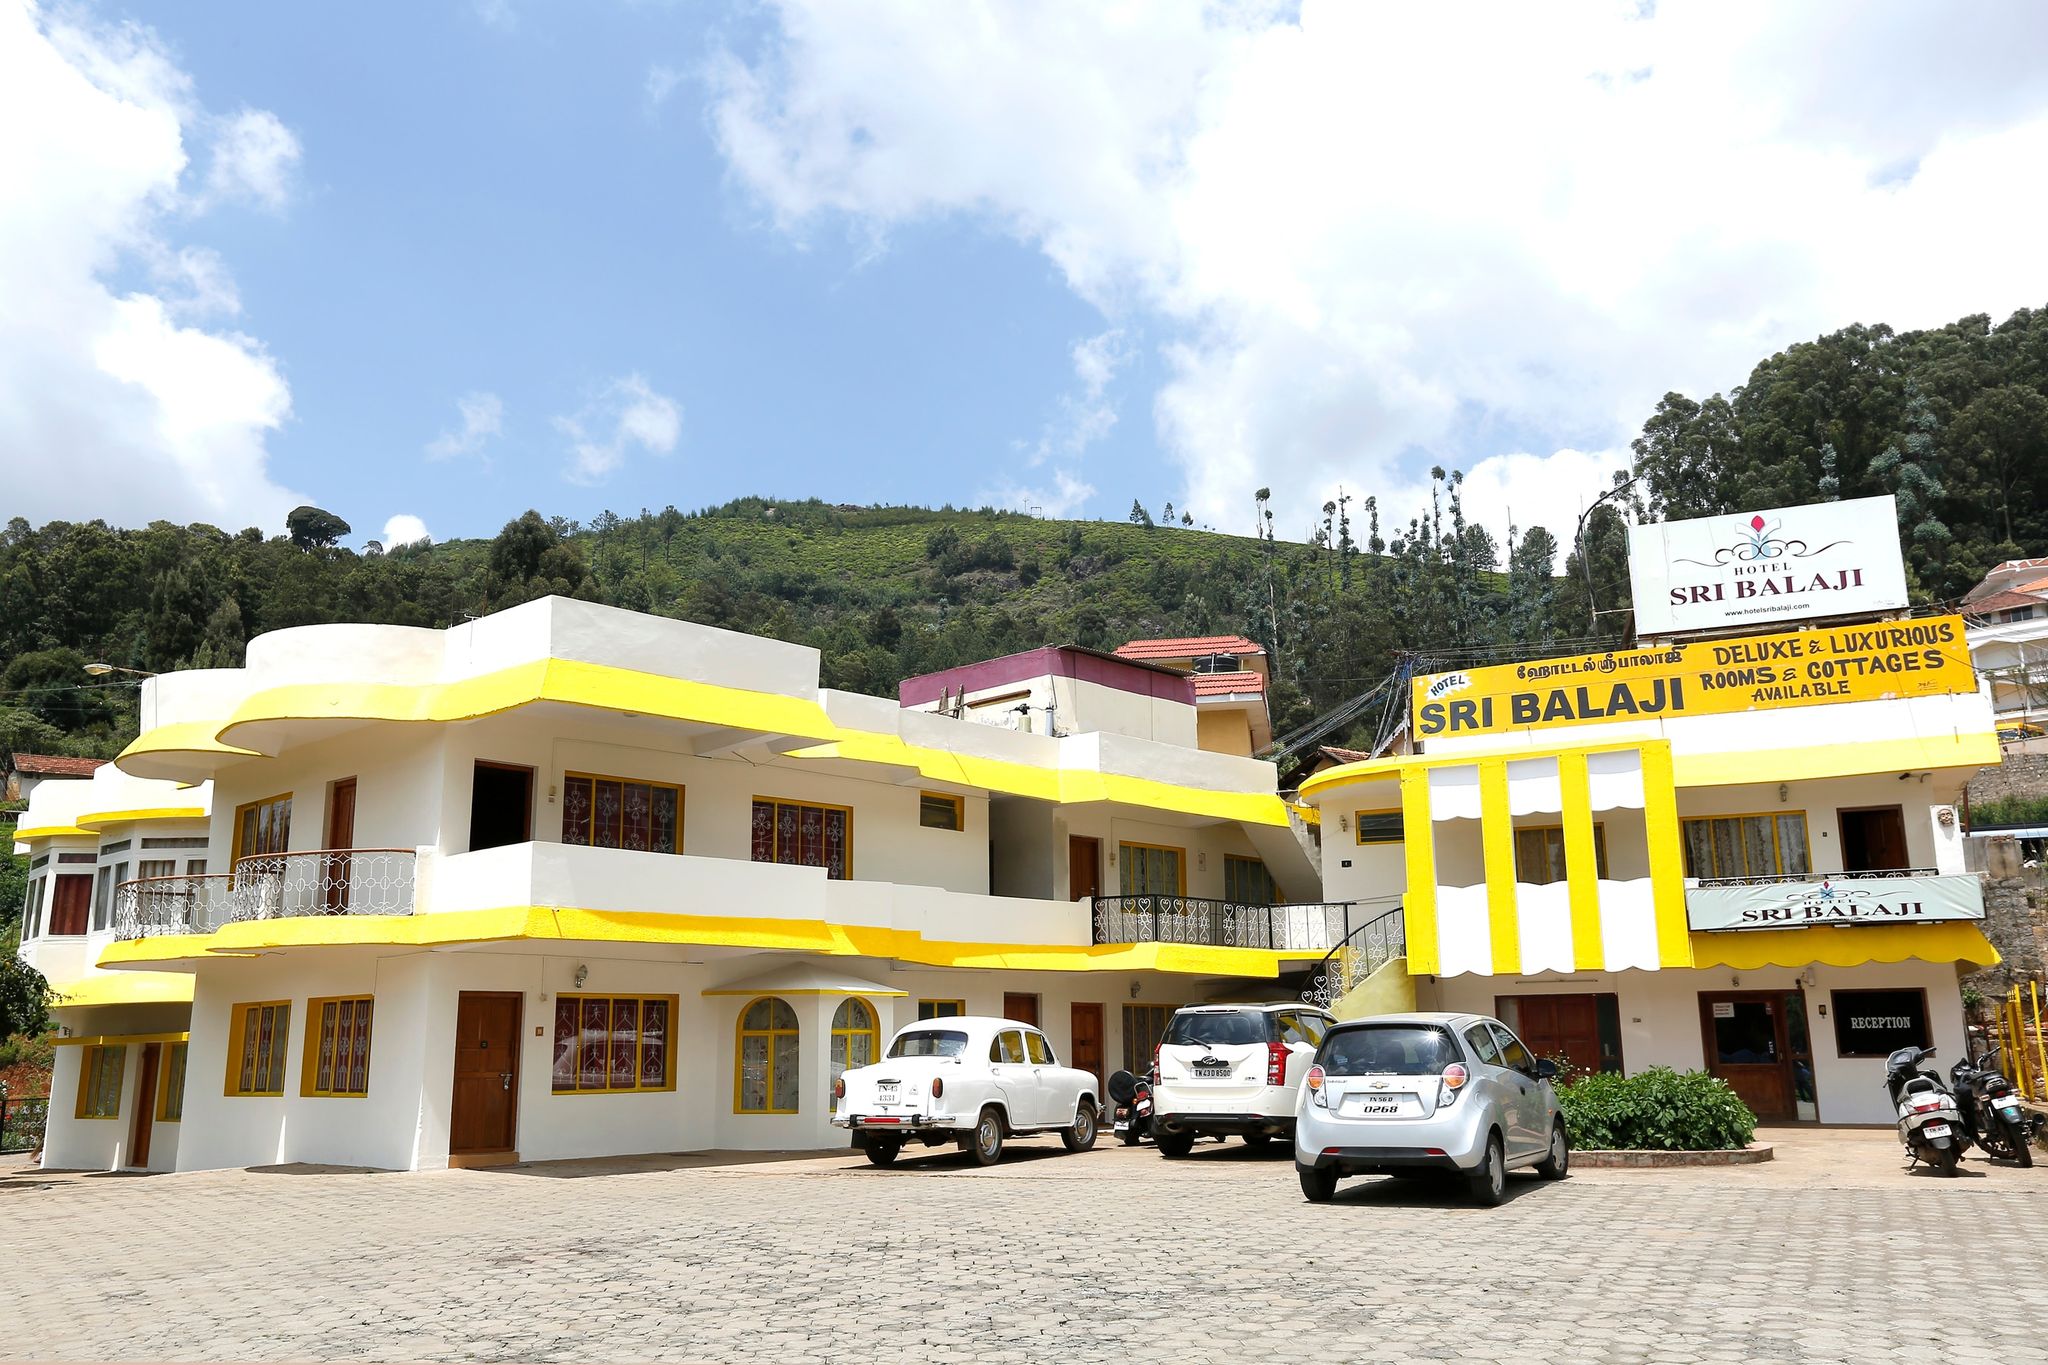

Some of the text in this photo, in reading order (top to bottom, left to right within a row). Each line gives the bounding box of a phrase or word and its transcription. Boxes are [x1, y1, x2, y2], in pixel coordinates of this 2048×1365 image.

[1734, 562, 1792, 576] HOTEL
[1670, 568, 1865, 606] SRI BALAJI
[1725, 603, 1810, 617] www.hotelsribalaji.com
[1712, 623, 1955, 665] DELUXE & LUXURIOUS
[1699, 649, 1945, 691] ROOMS & COTTAGES
[1431, 675, 1466, 697] HOTEL
[1750, 680, 1852, 702] AVAILABLE
[1419, 677, 1685, 735] SRI BALAJI
[1742, 908, 1792, 923] SRI
[1804, 901, 1924, 919] BALAJI
[1851, 1017, 1911, 1029] RECEPTION
[1364, 1105, 1398, 1113] 0268
